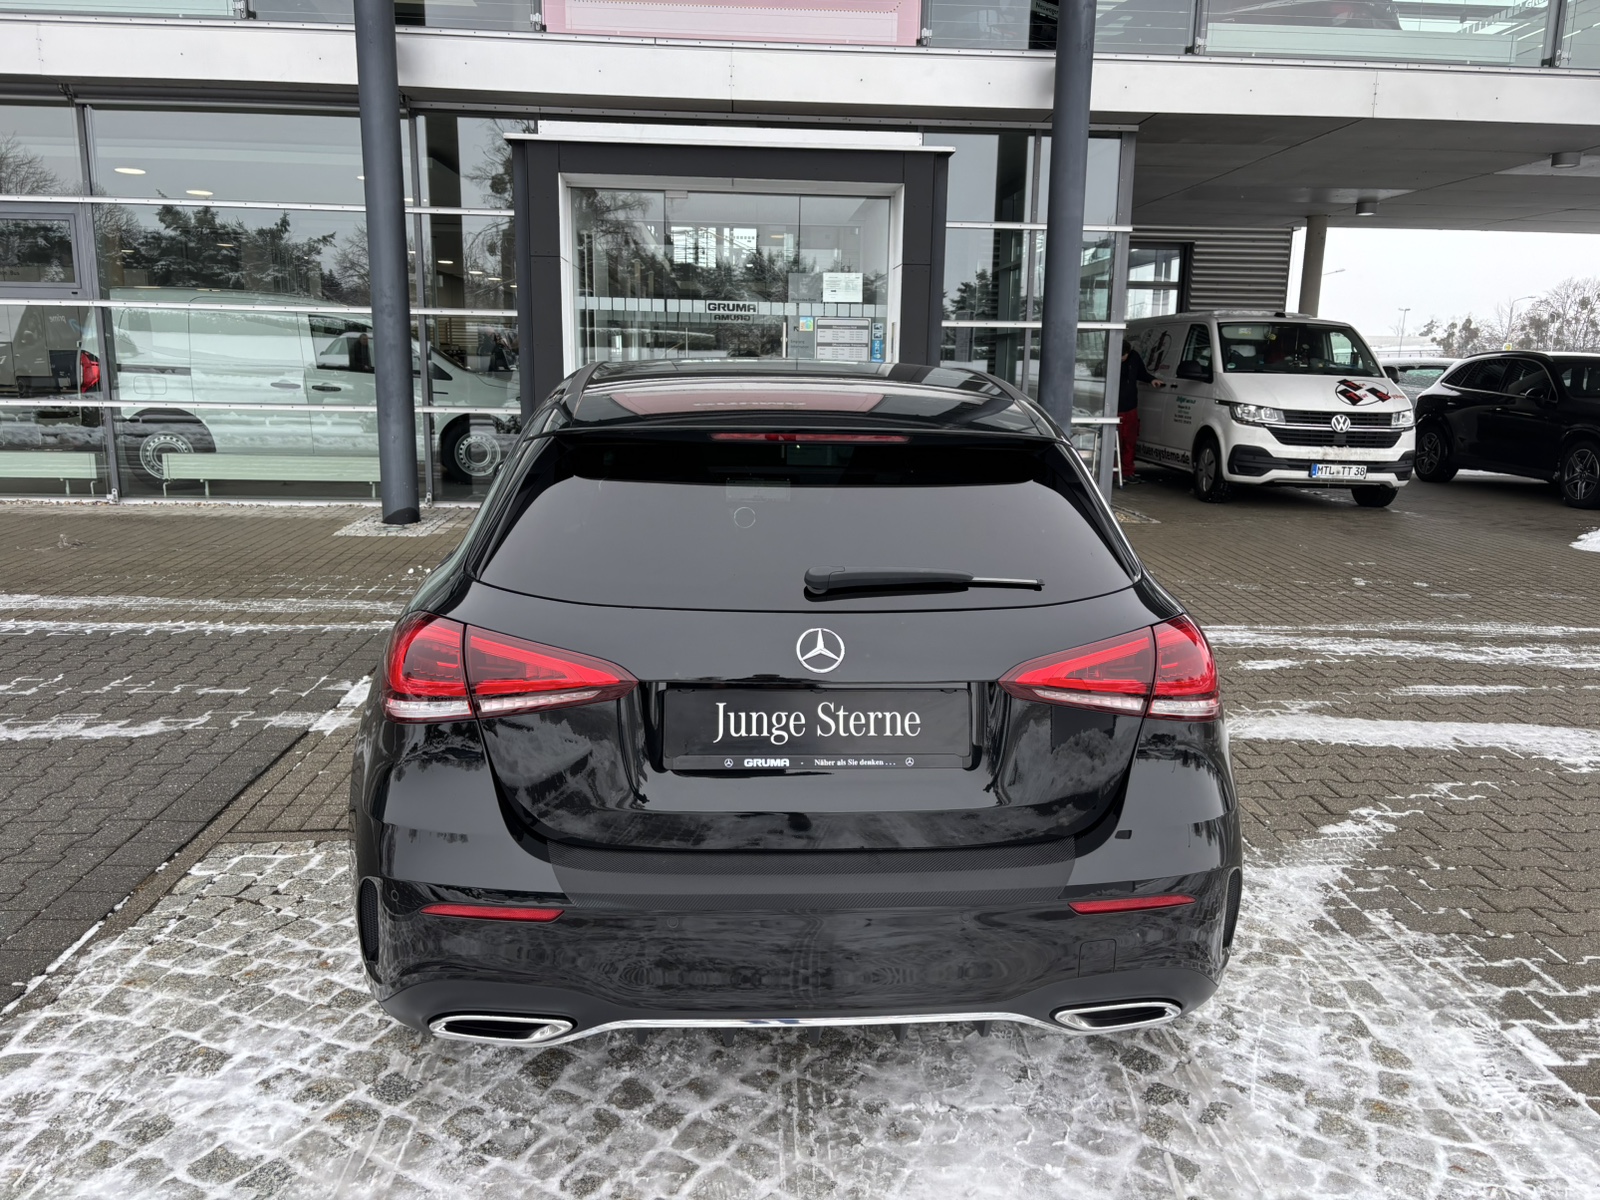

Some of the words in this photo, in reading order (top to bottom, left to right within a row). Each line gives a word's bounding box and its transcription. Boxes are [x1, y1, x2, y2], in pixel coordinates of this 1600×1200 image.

[708, 303, 756, 312] GRUMA
[1316, 465, 1334, 475] MTL
[1341, 466, 1352, 475] TT
[1354, 467, 1366, 476] 38
[713, 702, 806, 746] Junge
[817, 701, 921, 737] Sterne
[744, 758, 790, 768] GRUMA
[814, 758, 835, 767] Näher
[836, 758, 846, 767] als
[847, 758, 858, 767] Sie
